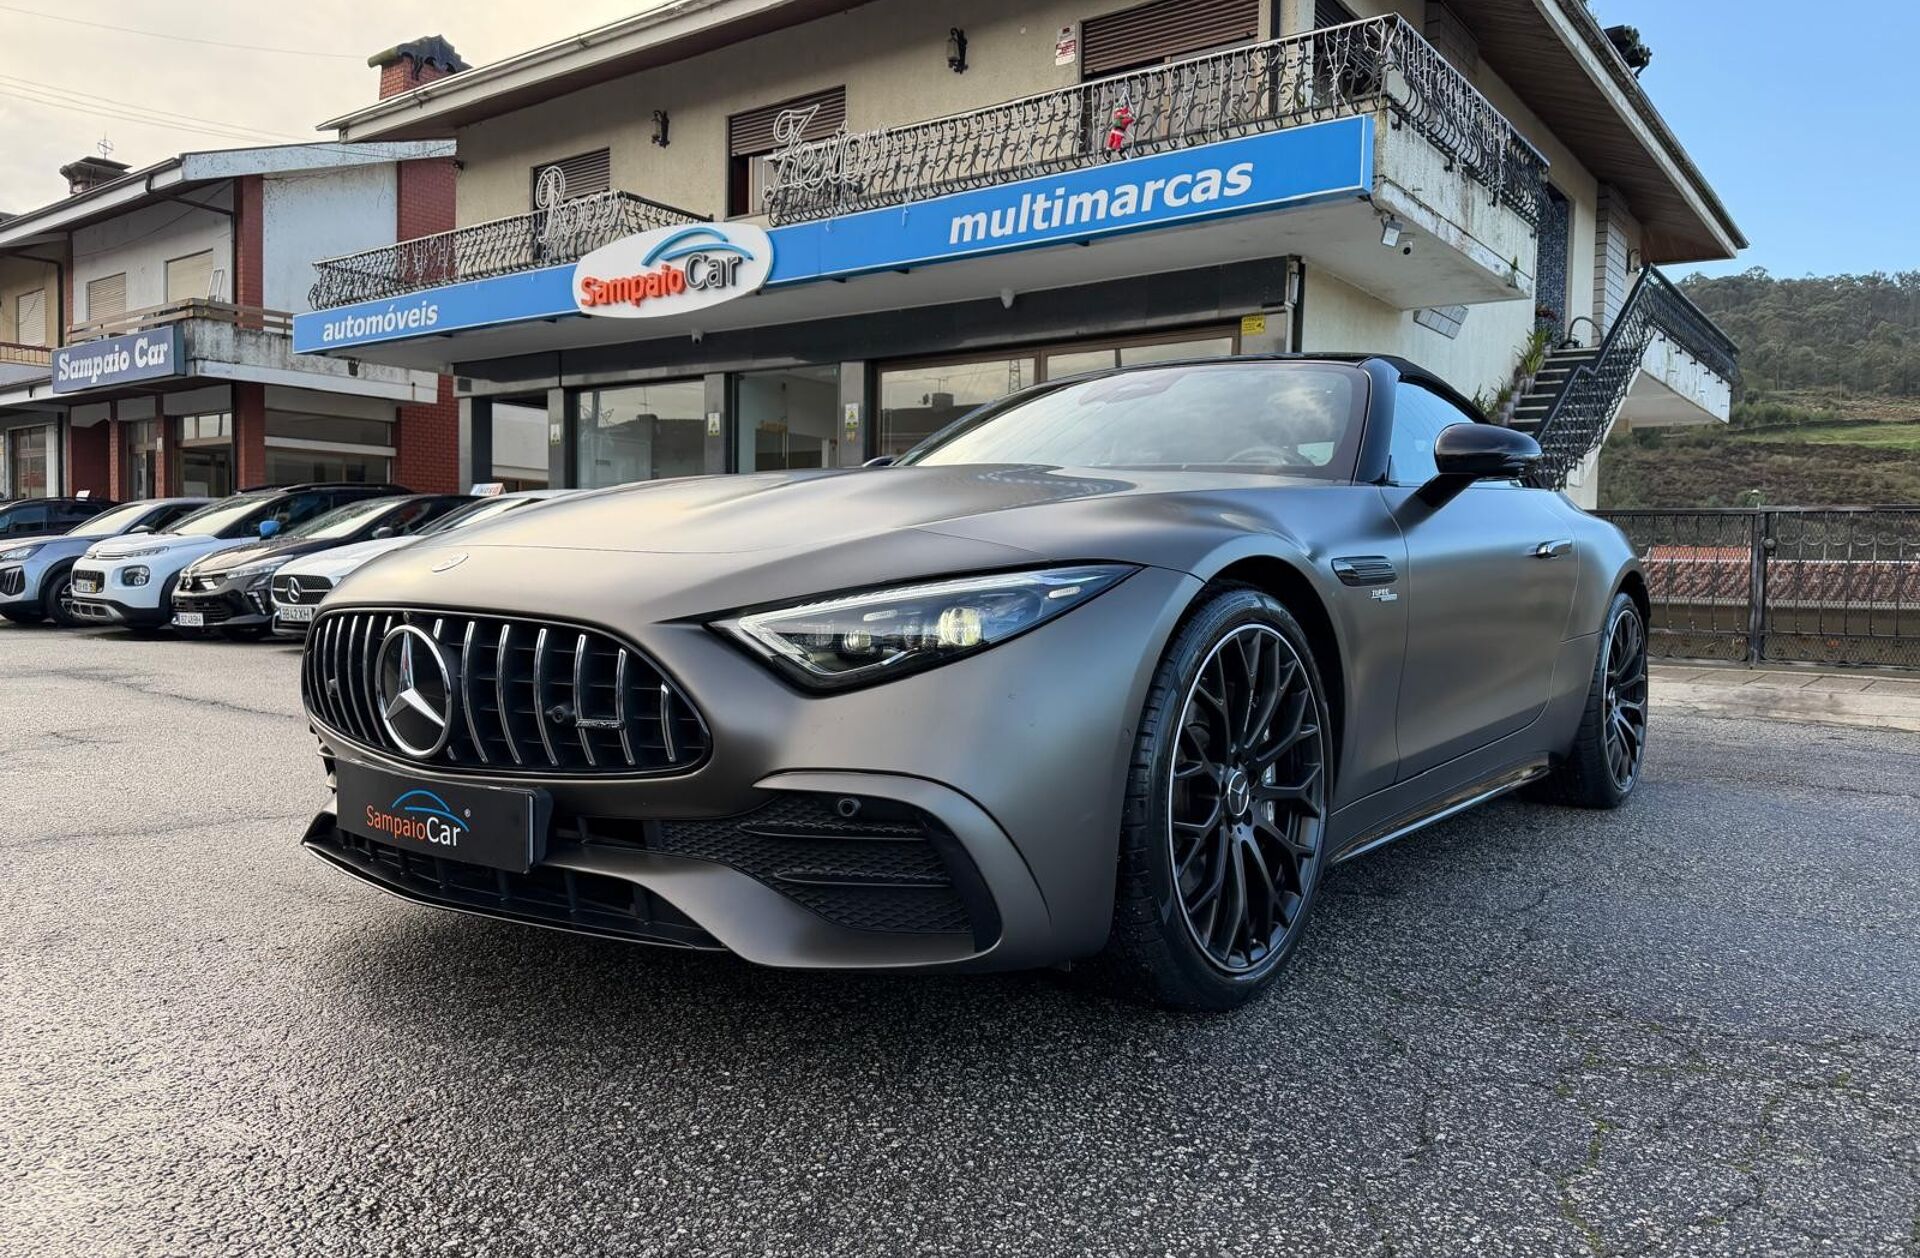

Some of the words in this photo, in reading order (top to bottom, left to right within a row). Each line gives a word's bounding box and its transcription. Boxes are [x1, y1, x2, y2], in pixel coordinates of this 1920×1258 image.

[949, 162, 1254, 245] multimarcas
[580, 252, 744, 308] SampaioCar
[323, 300, 439, 342] automóveis
[58, 344, 131, 384] Sampaio
[134, 337, 169, 369] Car
[366, 804, 462, 847] SampaioCar
